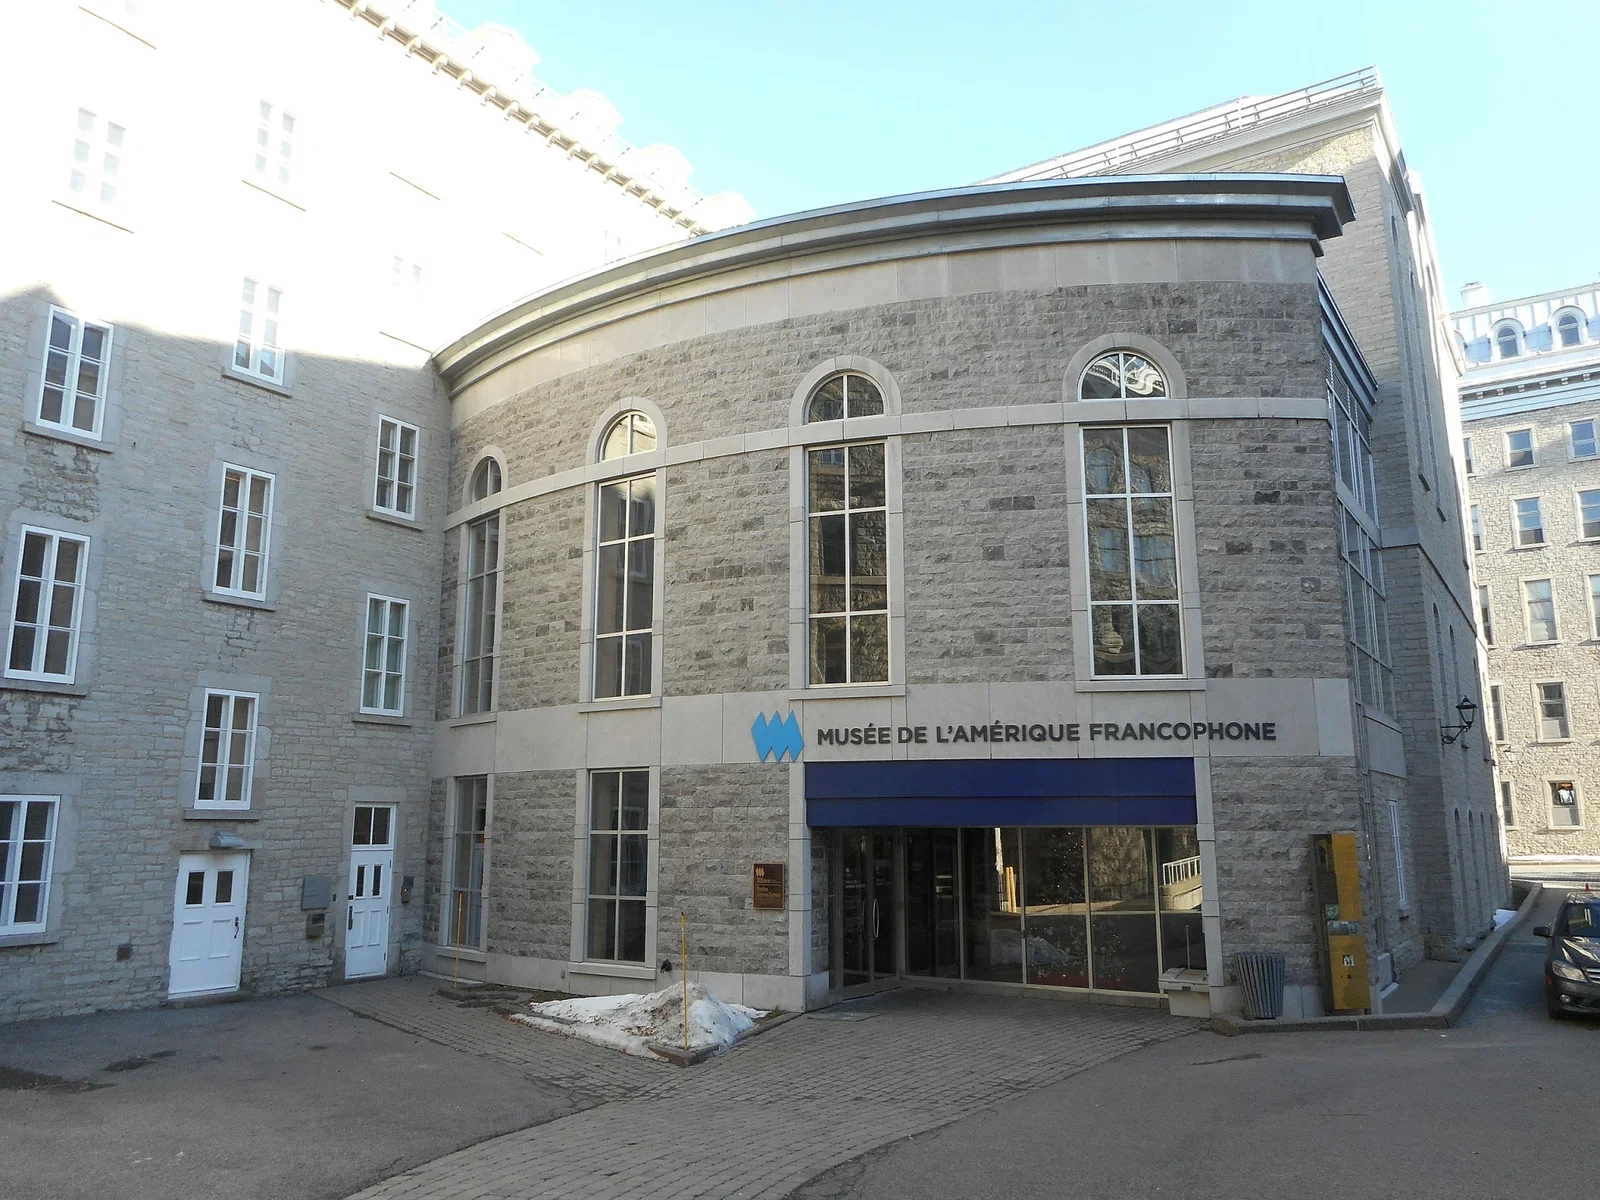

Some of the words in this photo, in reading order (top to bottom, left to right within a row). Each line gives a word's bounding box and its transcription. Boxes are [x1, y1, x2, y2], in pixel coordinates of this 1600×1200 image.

[817, 722, 891, 746] MUSÉE
[897, 726, 928, 744] DE
[936, 719, 1080, 744] L'AMÉRIQUE
[1089, 722, 1277, 741] FRANCOPHONE
